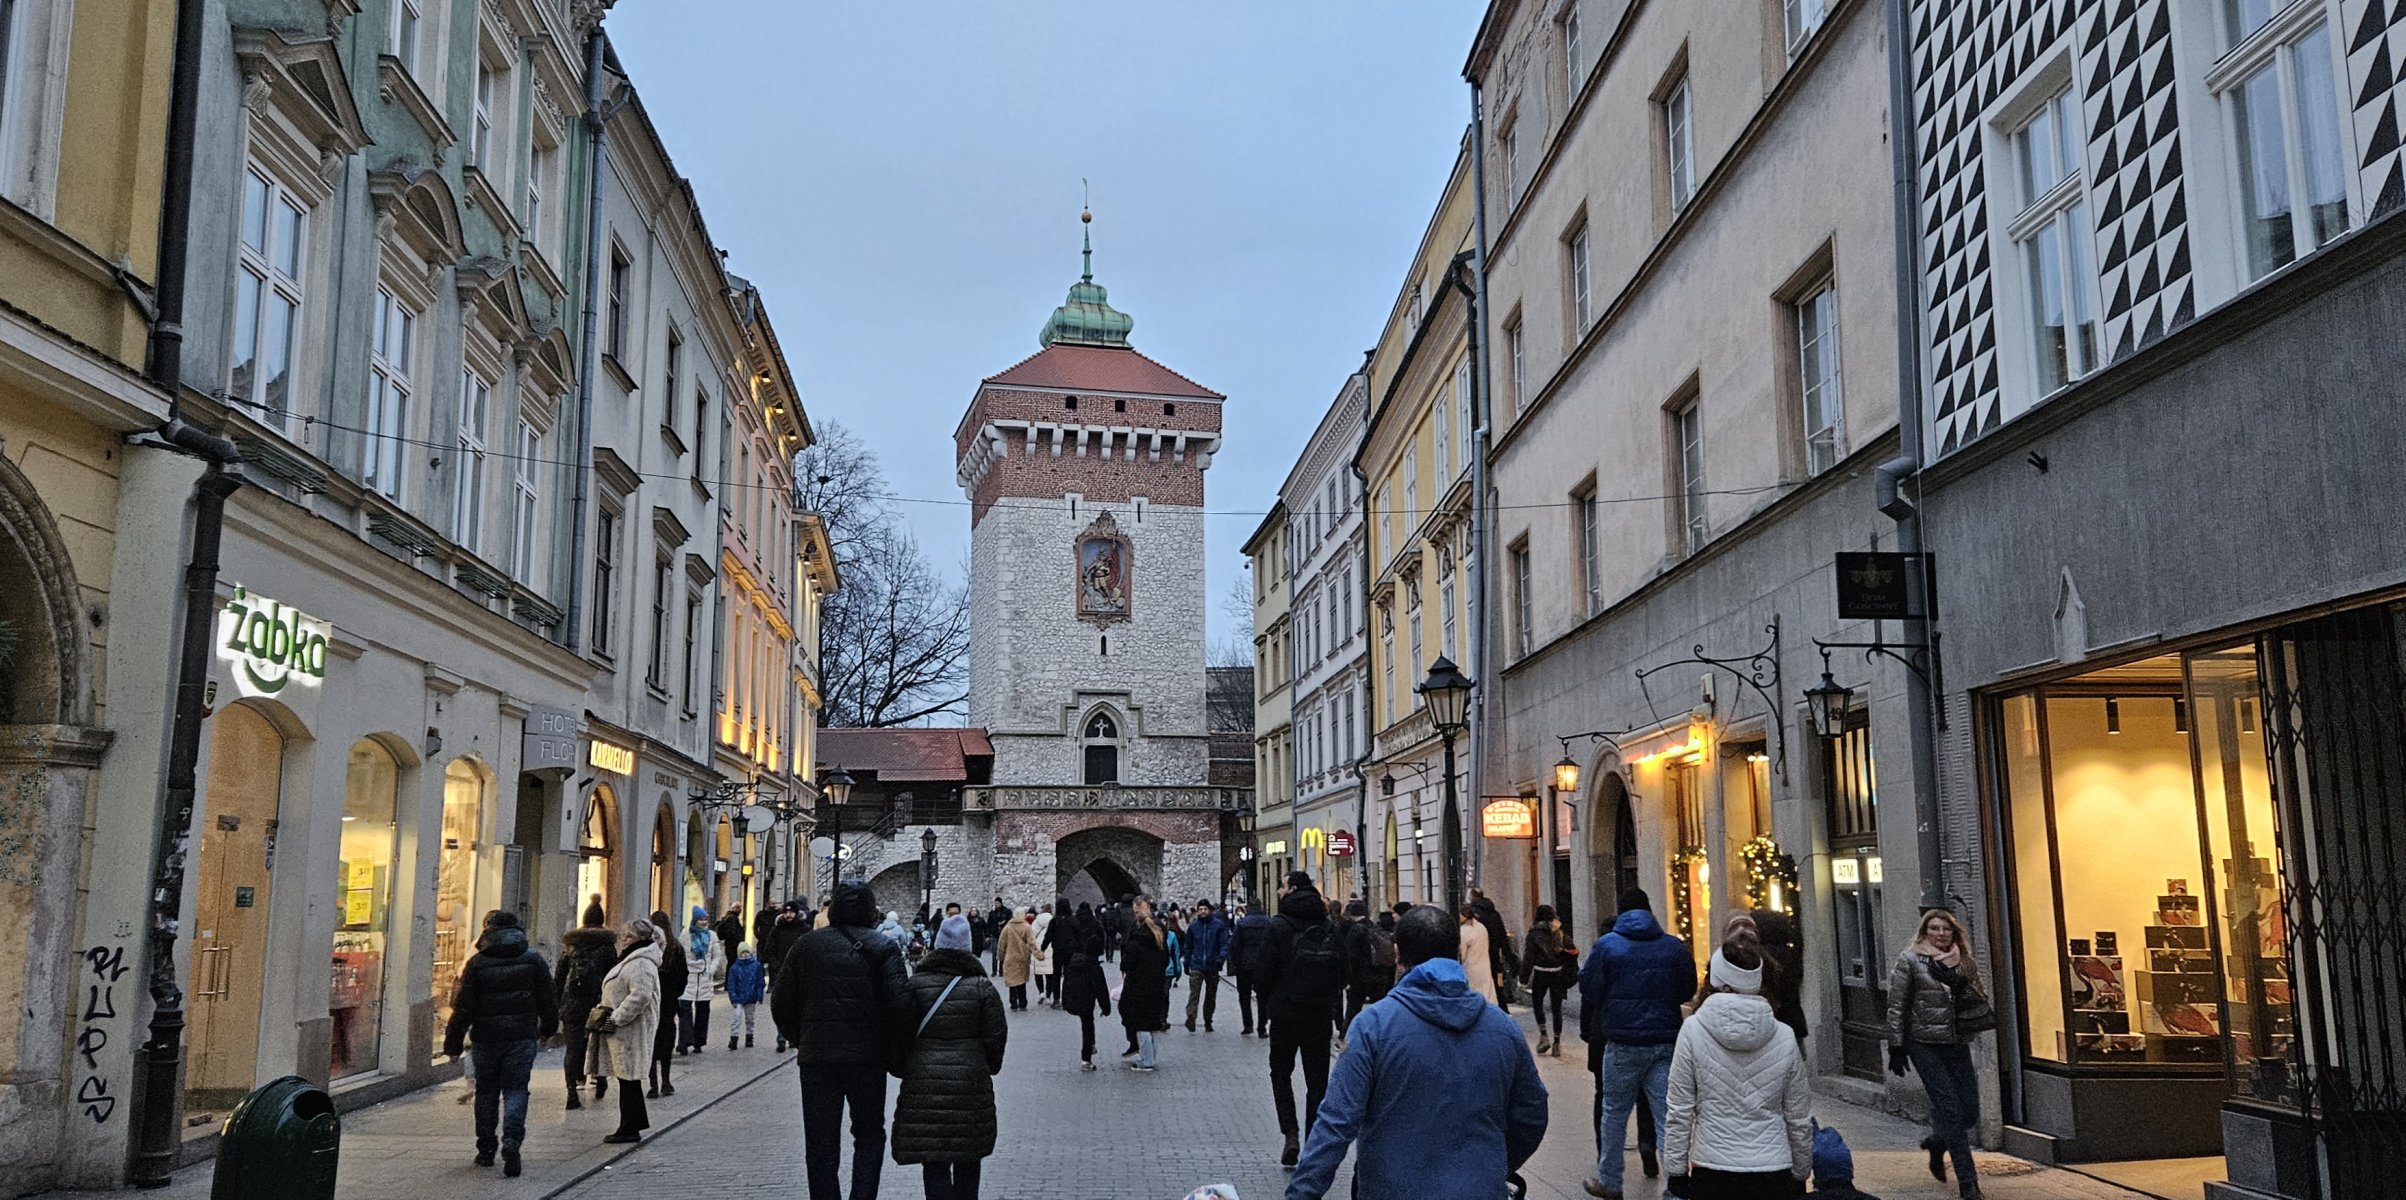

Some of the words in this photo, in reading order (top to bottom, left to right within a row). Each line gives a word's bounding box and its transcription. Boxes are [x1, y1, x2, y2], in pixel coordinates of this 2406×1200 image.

[225, 586, 326, 678] żabka
[590, 740, 634, 776] KARMELLO
[1485, 812, 1531, 825] KEBAB
[1838, 863, 1854, 879] ATM
